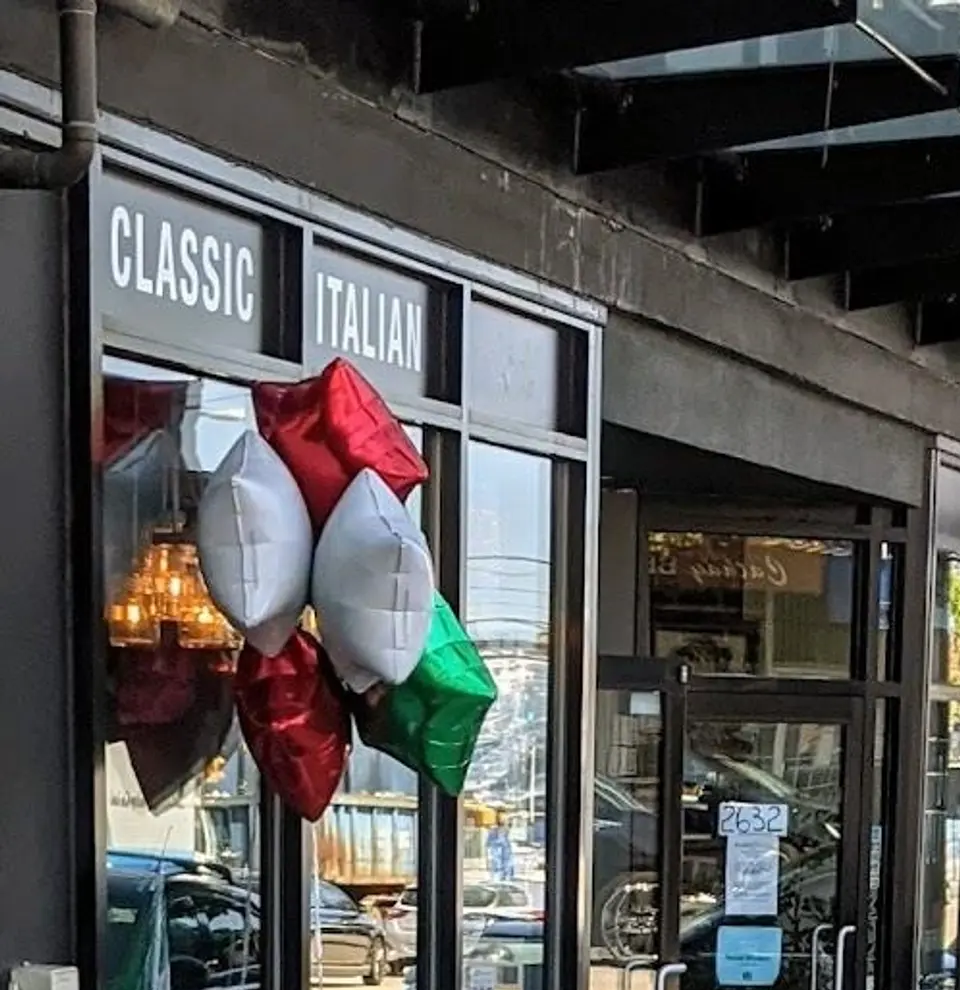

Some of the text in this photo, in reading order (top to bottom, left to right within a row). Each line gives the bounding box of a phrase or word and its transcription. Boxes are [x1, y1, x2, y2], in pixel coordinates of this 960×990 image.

[111, 205, 421, 373] CLASSIC ITALIAN
[720, 805, 784, 834] 2632
